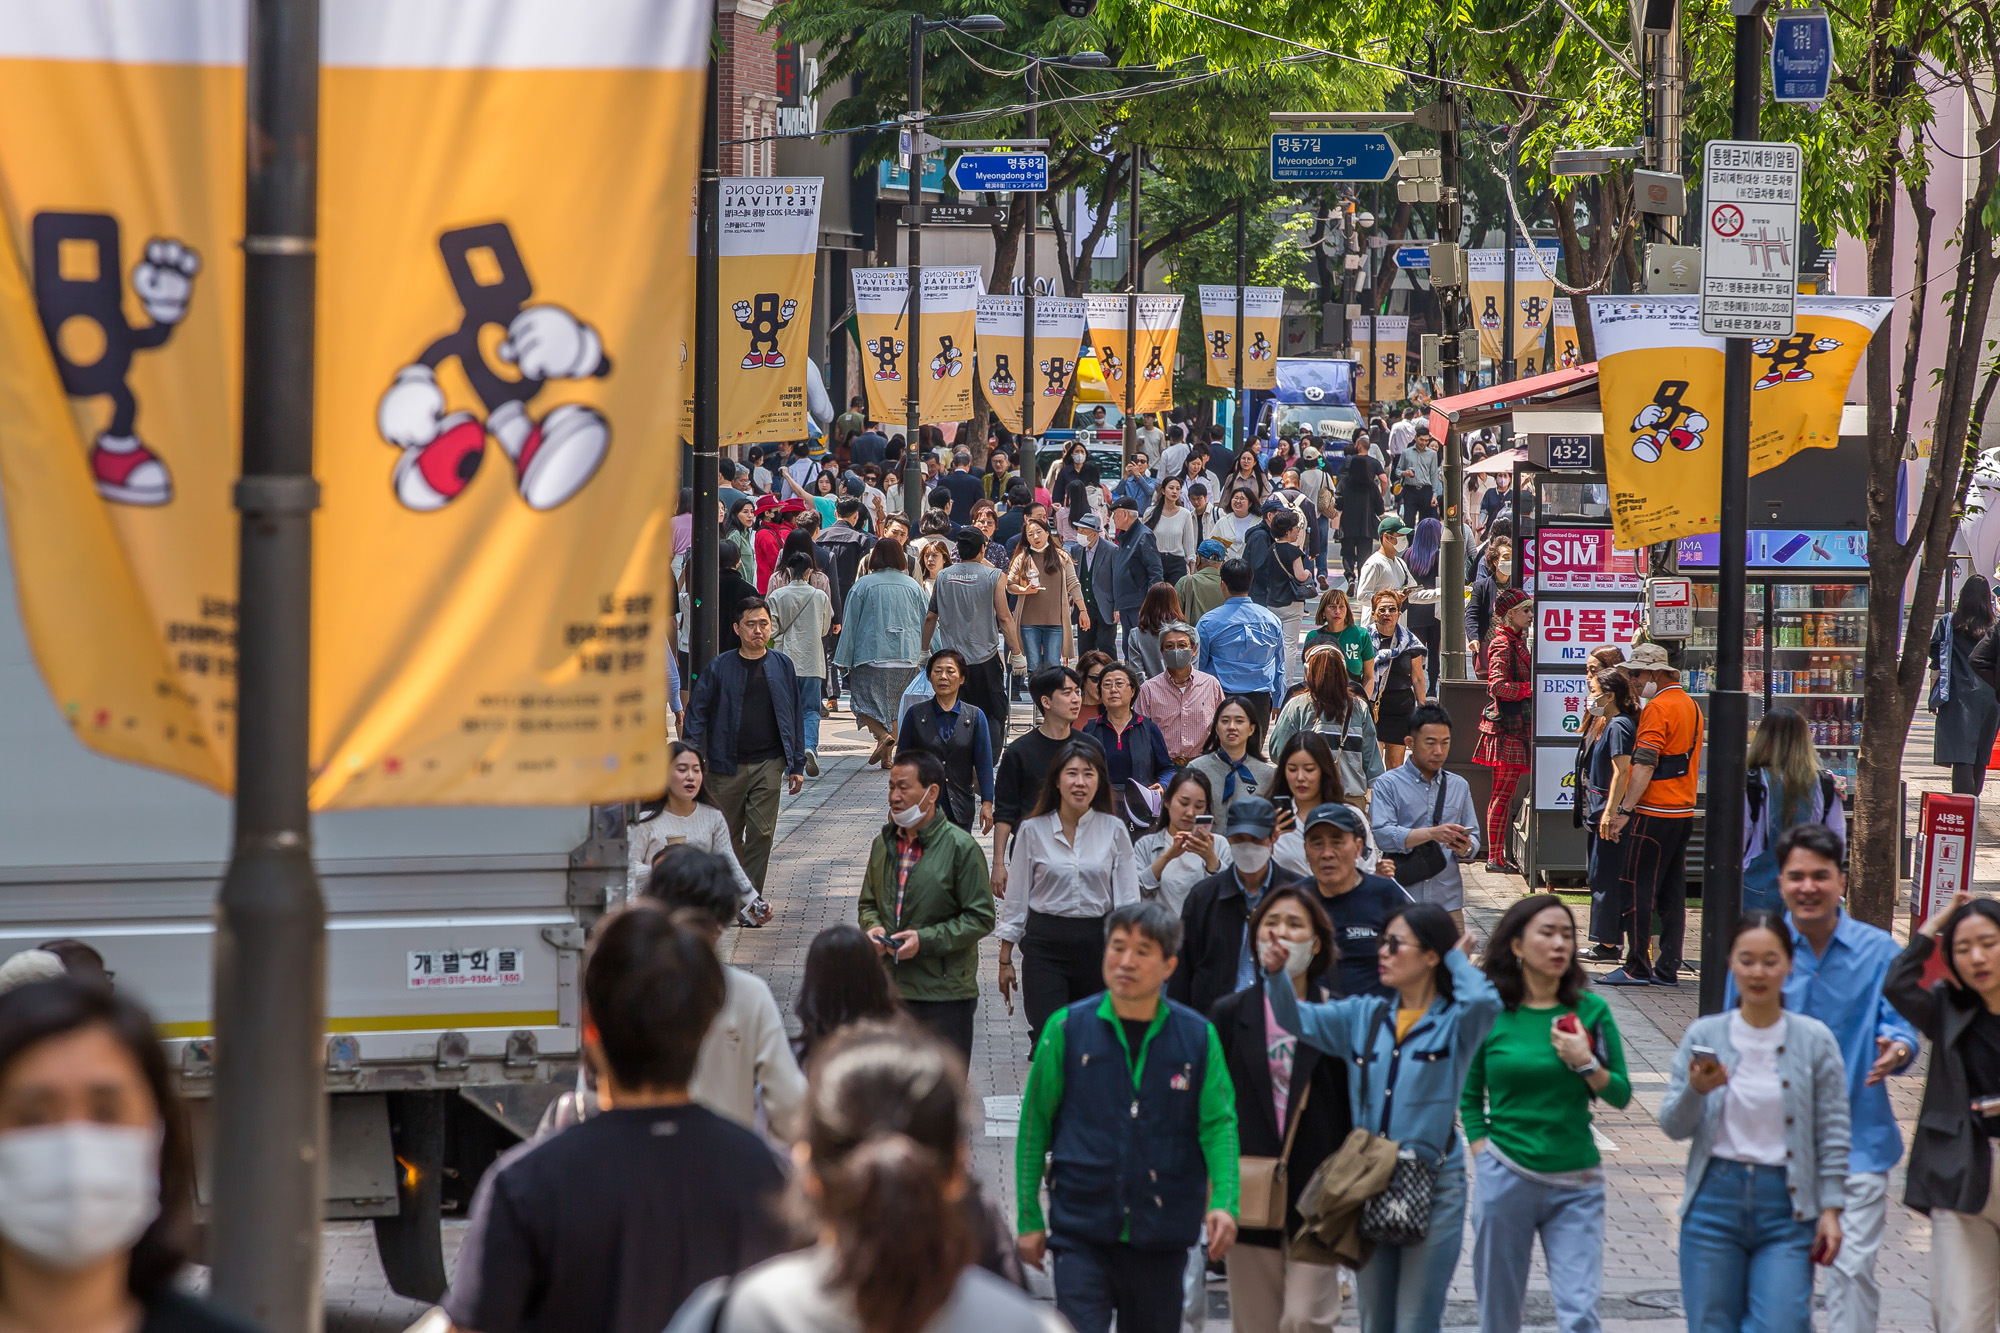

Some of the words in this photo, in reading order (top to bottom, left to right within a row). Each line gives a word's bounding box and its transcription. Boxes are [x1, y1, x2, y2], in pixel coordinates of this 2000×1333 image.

[1278, 138, 1320, 152] 명동7길
[1008, 158, 1044, 170] 명동8길
[1278, 156, 1334, 166] Myeongdong
[1336, 156, 1356, 166] 7-gil
[1713, 148, 1794, 168] 통행금지(제한)알림
[976, 172, 1024, 180] Myeongdong
[1026, 172, 1044, 180] 8-gil
[1764, 174, 1792, 186] 모든차량
[1729, 282, 1773, 293] 명동관광특구
[1775, 284, 1790, 294] 일대
[1714, 318, 1781, 330] 남대문경찰서장
[1552, 445, 1587, 459] 43-2
[1542, 540, 1596, 565] SIM
[1544, 609, 1640, 642] 상품권
[1562, 648, 1585, 658] 사고
[1543, 680, 1586, 693] BEST
[1565, 717, 1578, 730] 元
[1937, 813, 1964, 825] 사용법
